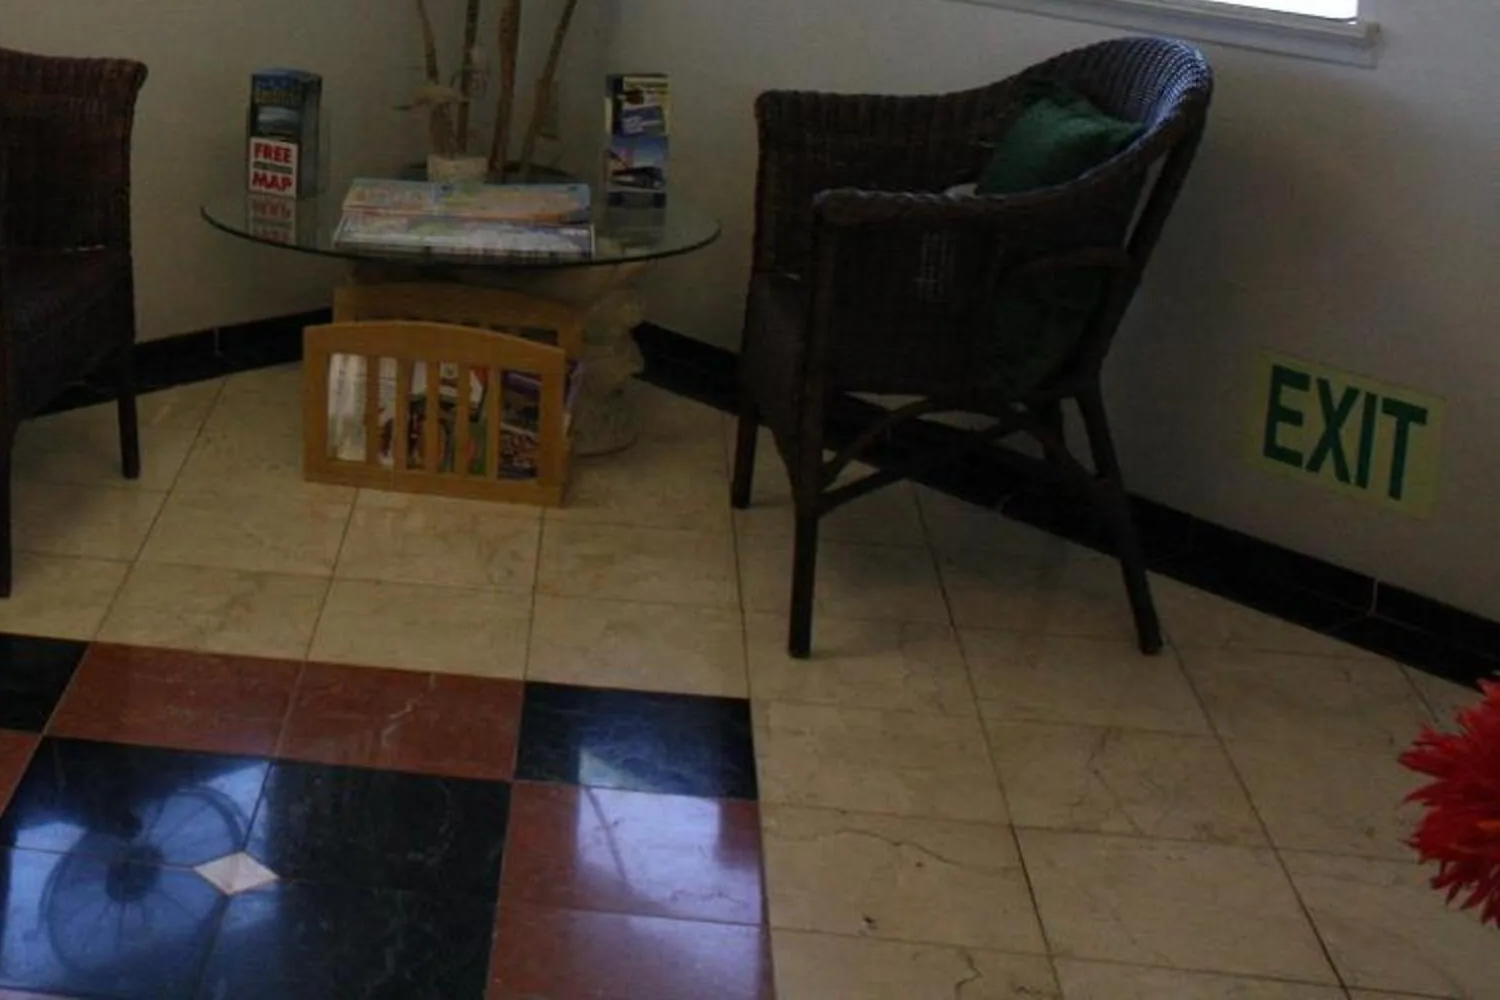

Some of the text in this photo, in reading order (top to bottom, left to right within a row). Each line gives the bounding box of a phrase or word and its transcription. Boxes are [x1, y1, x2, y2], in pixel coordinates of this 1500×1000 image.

[253, 141, 292, 164] FREE
[252, 171, 293, 192] MAP
[1264, 364, 1428, 501] EXIT
